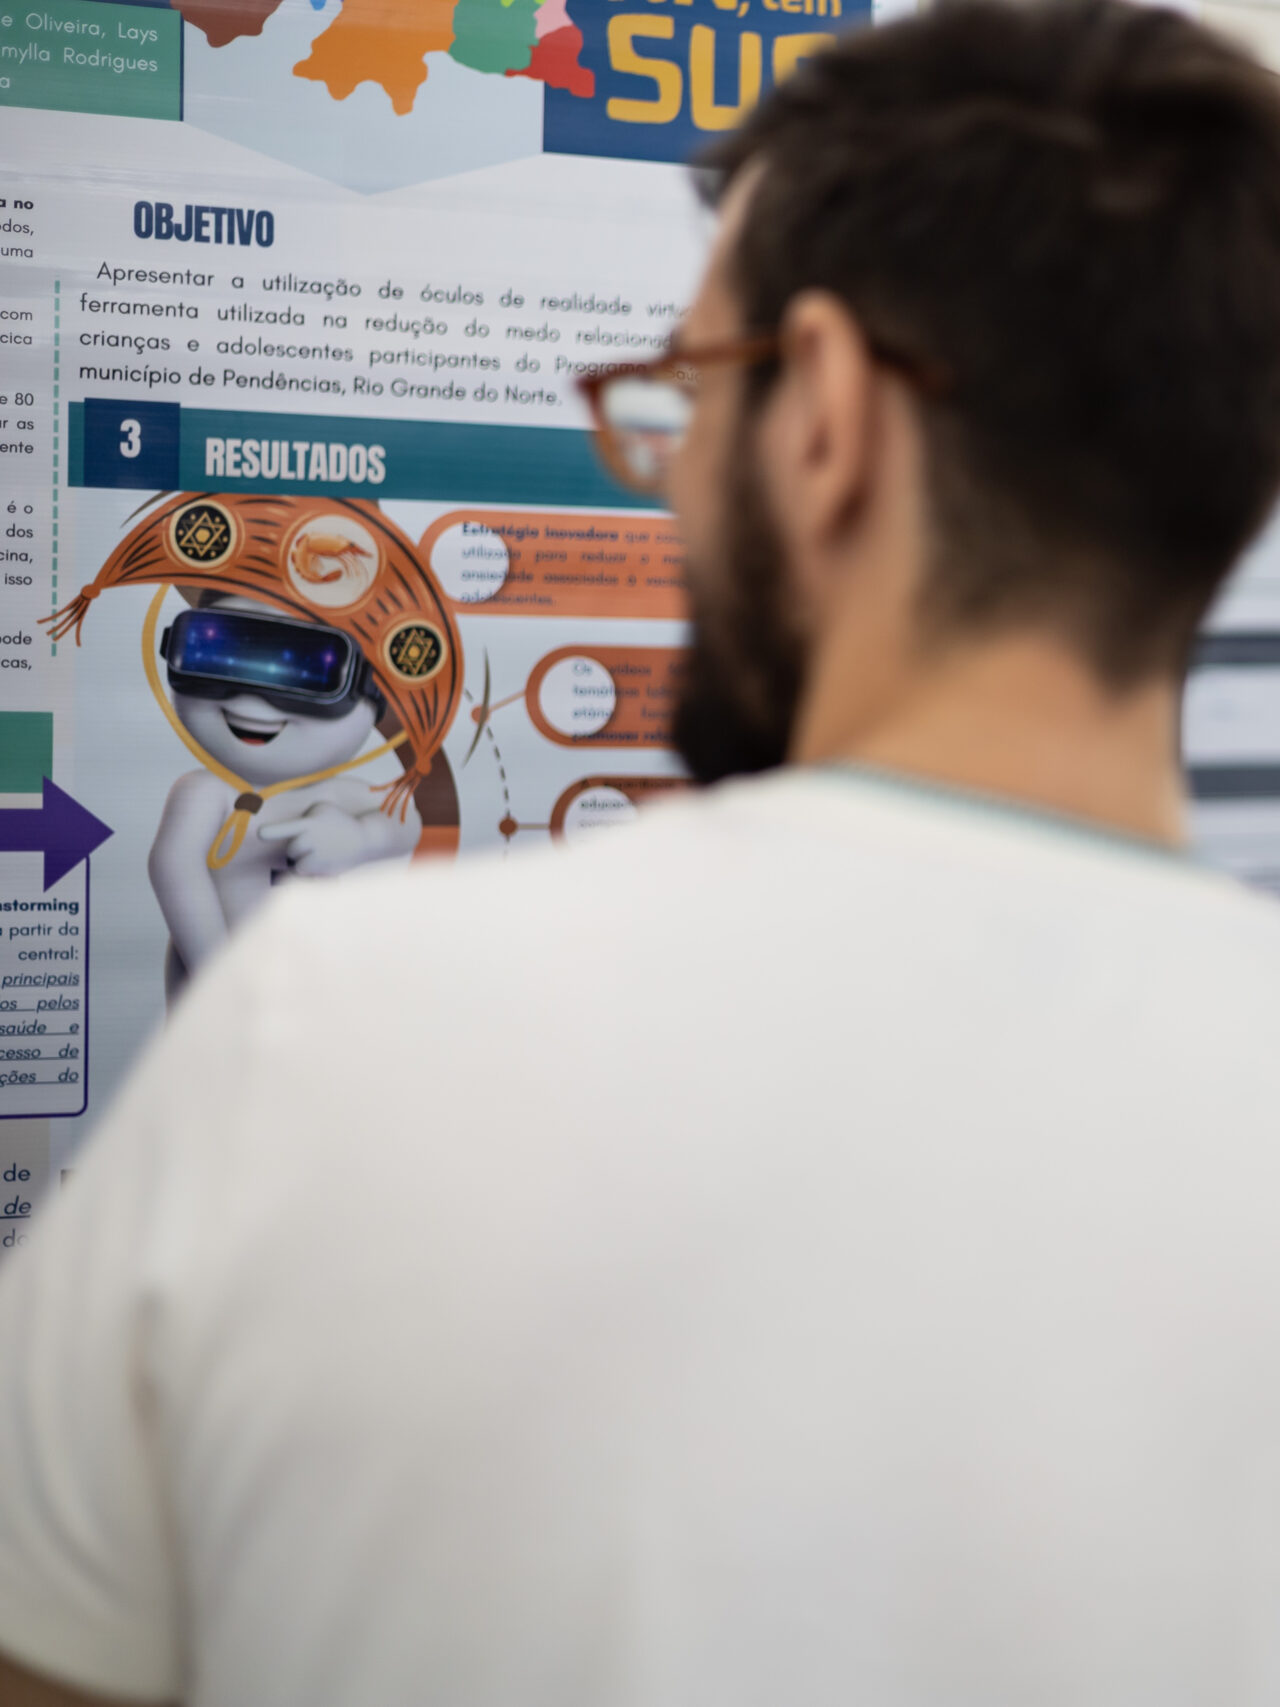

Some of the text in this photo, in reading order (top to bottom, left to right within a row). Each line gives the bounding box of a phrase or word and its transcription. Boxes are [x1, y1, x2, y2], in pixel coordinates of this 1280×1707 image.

[1, 12, 158, 45] e Oliveira, Lays
[0, 42, 158, 73] mylla Rodrigues
[14, 199, 34, 210] no
[0, 218, 34, 236] dos,
[134, 200, 275, 248] OBJETIVO
[1, 247, 33, 258] uma
[97, 261, 214, 287] Apresentar
[232, 274, 245, 289] a
[263, 273, 362, 301] utilização
[378, 280, 404, 300] de
[420, 284, 484, 306] óculos
[500, 288, 525, 309] de
[540, 291, 632, 317] realidade
[79, 292, 199, 320] ferramenta
[217, 303, 305, 327] utilizada
[323, 314, 348, 330] na
[366, 312, 448, 339] redução
[464, 318, 490, 339] do
[506, 321, 560, 342] medo
[0, 332, 33, 345] cica
[79, 331, 170, 354] crianças
[187, 338, 199, 352] e
[217, 335, 353, 363] adolescentes
[369, 346, 501, 375] participantes
[516, 352, 541, 374] do
[79, 364, 562, 407] município de Pendências, Rio Grande do Norte.
[14, 392, 34, 406] 80
[17, 420, 34, 430] as
[119, 418, 142, 459] 3
[0, 441, 34, 455] ente
[205, 436, 386, 485] RESULTADOS
[24, 504, 34, 515] o
[6, 524, 34, 539] dos
[0, 550, 33, 564] cina,
[5, 573, 33, 586] isso
[0, 630, 32, 645] ode
[1, 657, 32, 671] cas,
[0, 897, 79, 916] storming
[9, 922, 53, 941] partir
[58, 920, 79, 937] da
[18, 945, 79, 961] central:
[1, 972, 80, 990] principais
[0, 993, 80, 1014] os pelos
[0, 1018, 80, 1036] saúde e
[0, 1042, 80, 1060] cesso de
[0, 1066, 79, 1088] ções do
[3, 1162, 31, 1182] de
[4, 1194, 32, 1216] de
